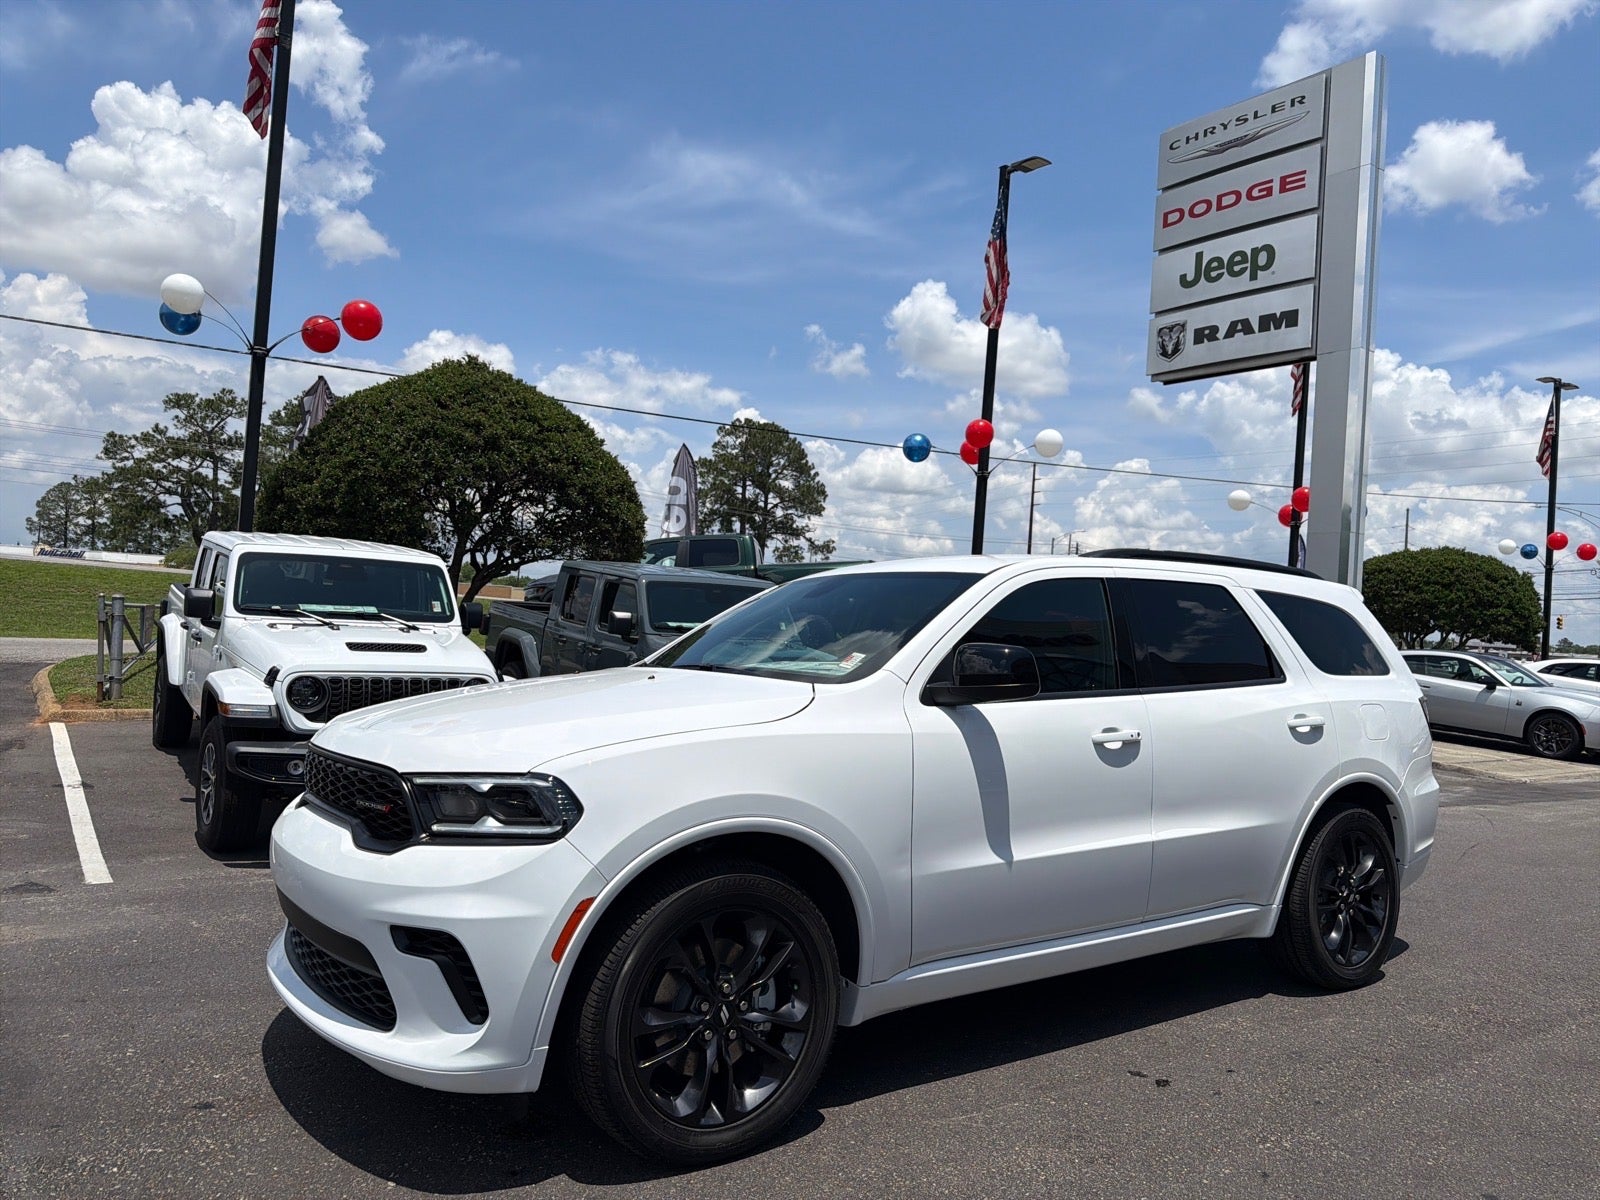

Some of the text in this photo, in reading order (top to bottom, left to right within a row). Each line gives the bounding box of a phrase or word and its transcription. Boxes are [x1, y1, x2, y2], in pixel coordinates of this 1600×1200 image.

[1169, 95, 1307, 151] CHRYSLER
[1162, 169, 1307, 229] DODGE
[1179, 243, 1276, 289] Jeep
[1193, 308, 1299, 345] RAM
